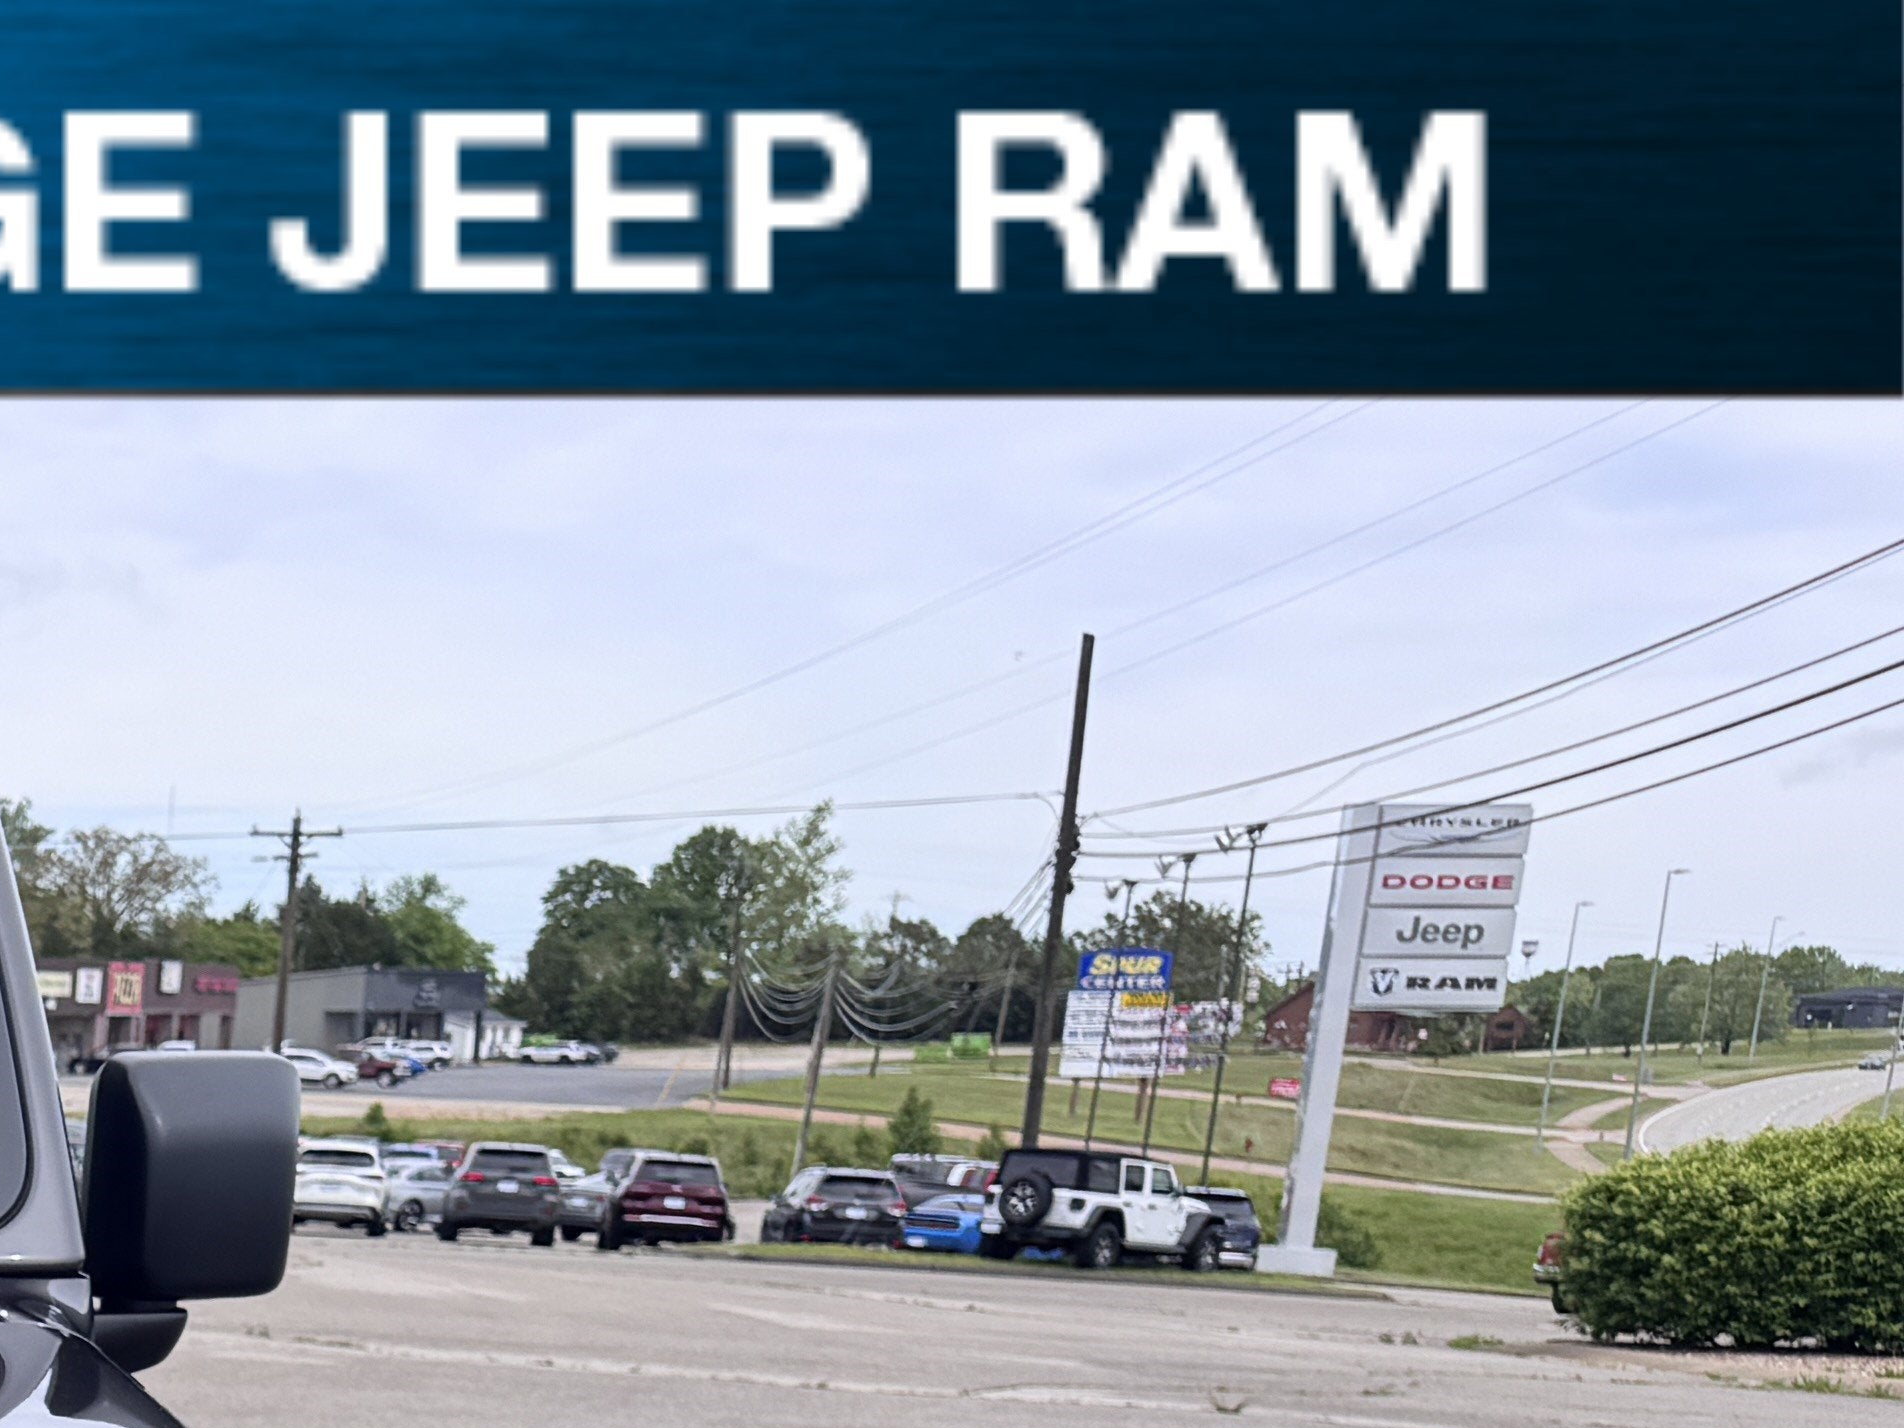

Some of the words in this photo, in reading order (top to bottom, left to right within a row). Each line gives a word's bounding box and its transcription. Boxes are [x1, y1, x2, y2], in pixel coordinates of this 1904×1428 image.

[1382, 874, 1515, 890] DODGE
[1396, 916, 1485, 950] Jeep
[1406, 976, 1498, 991] RAM
